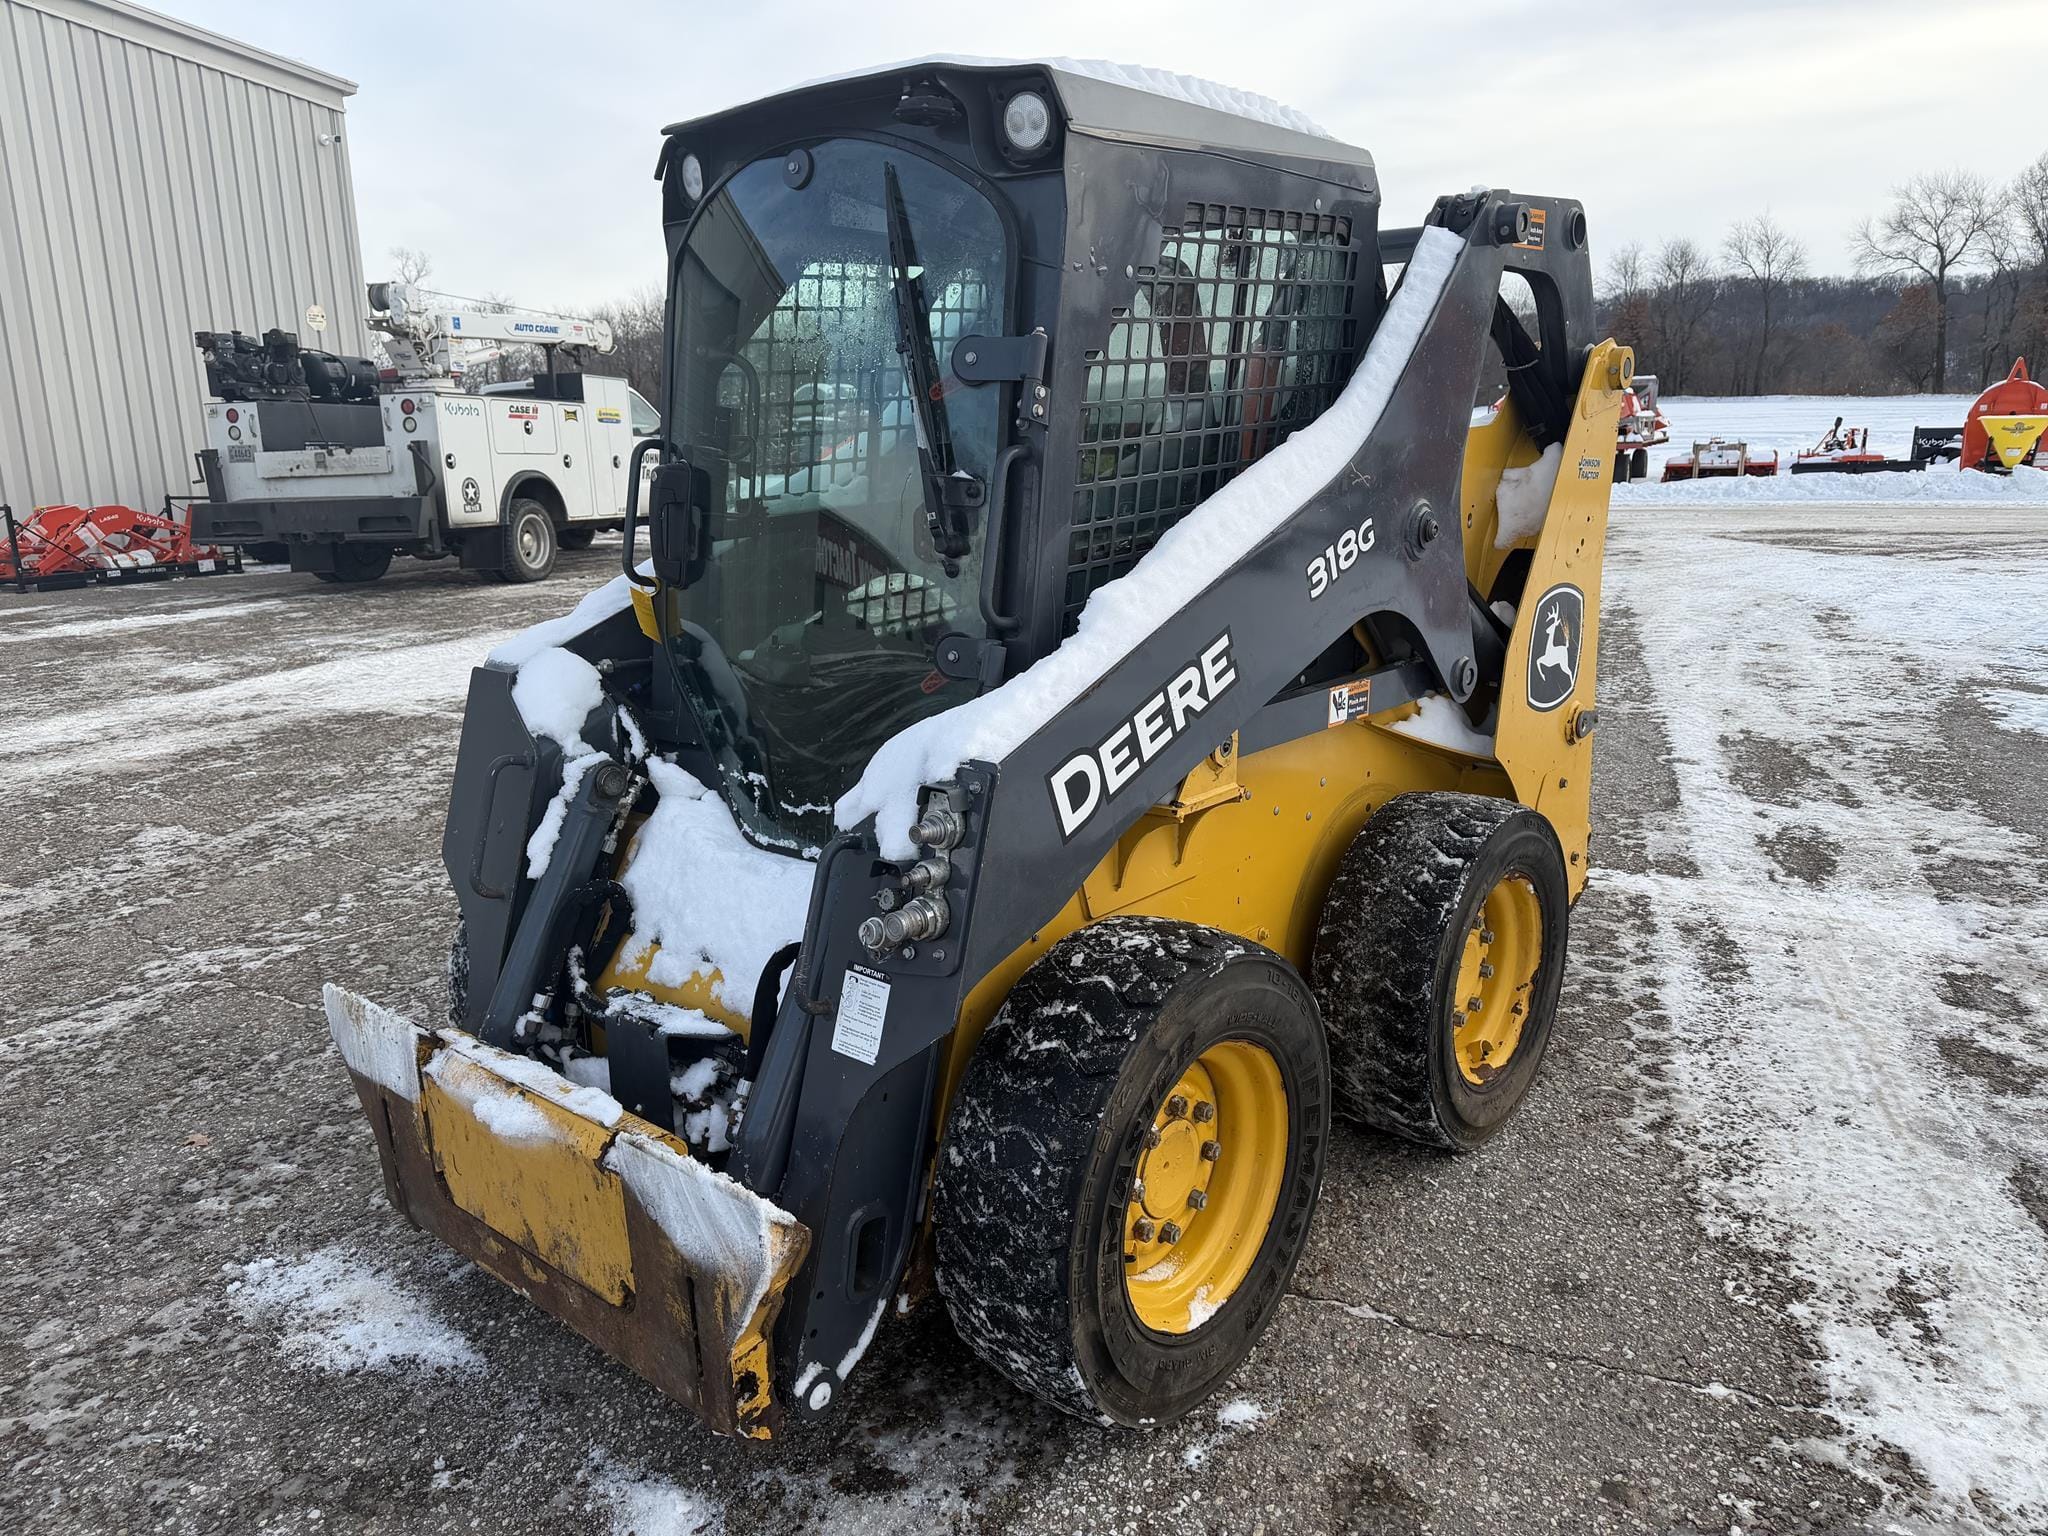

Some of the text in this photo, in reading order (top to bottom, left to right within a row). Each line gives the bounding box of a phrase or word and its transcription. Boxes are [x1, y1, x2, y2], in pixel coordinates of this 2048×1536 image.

[514, 323, 559, 334] AUTO CRANE
[444, 401, 480, 416] Kubota
[509, 404, 531, 414] CASE
[1579, 455, 1601, 467] JOHNSON
[1578, 468, 1600, 480] TRACTOR
[136, 513, 165, 527] Kubota
[1307, 517, 1375, 598] 318G
[1050, 634, 1237, 837] DEERE
[853, 964, 886, 980] IMPORTANT
[1246, 1037, 1321, 1331] LIFEMASTER
